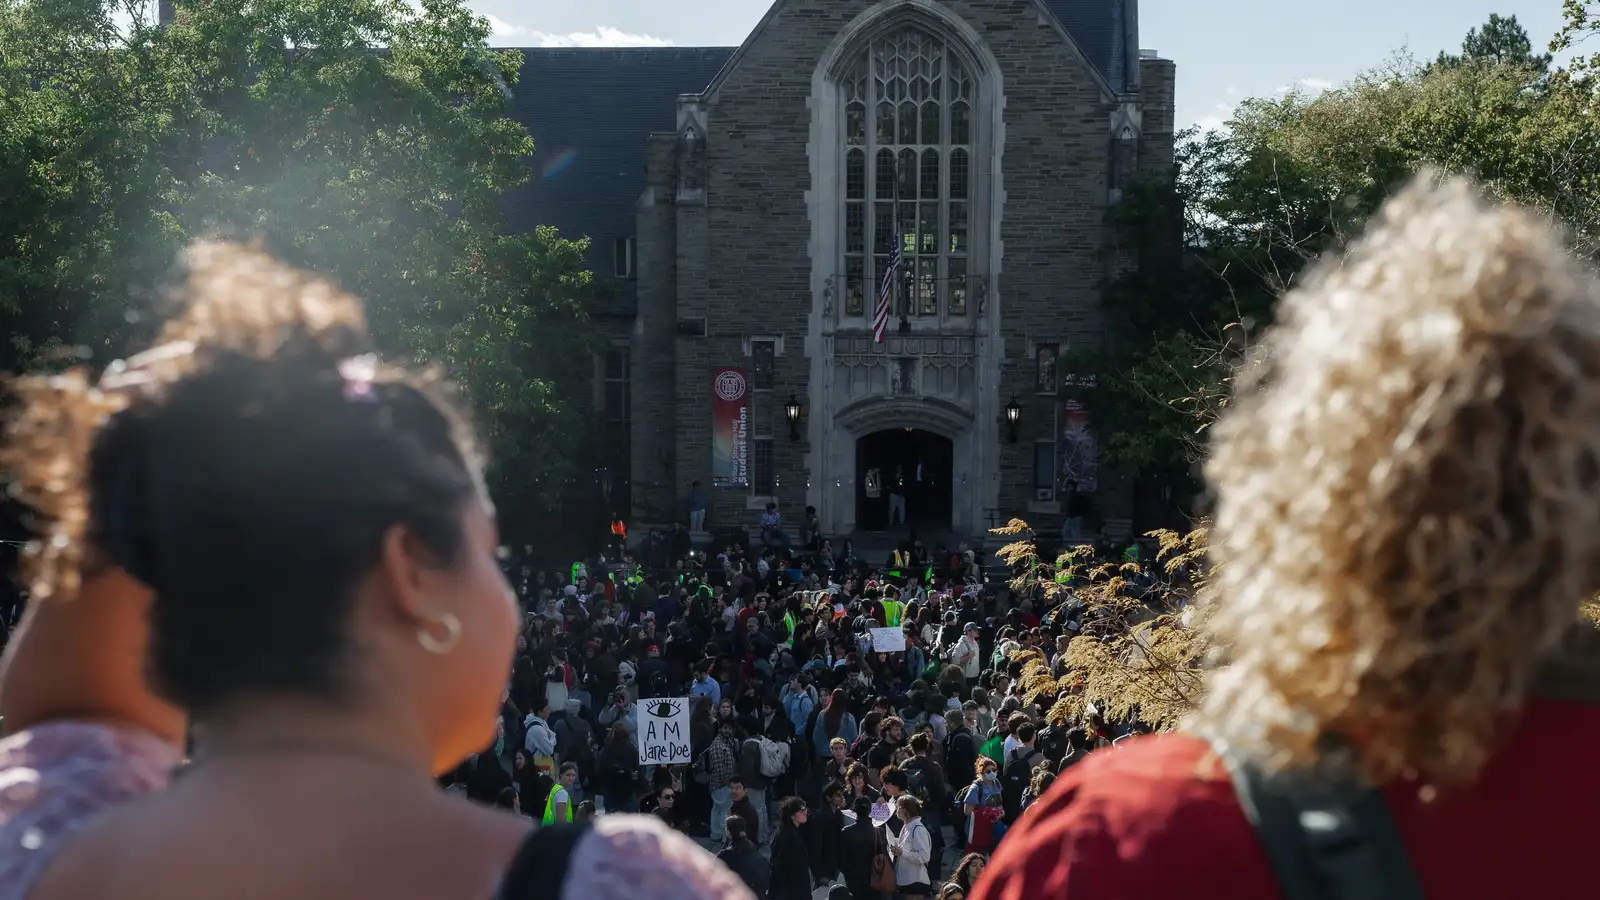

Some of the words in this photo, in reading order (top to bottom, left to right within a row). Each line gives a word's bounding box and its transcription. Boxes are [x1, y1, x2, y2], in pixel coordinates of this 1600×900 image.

[738, 406, 747, 438] Union
[738, 441, 747, 483] Student
[641, 741, 668, 763] Jane
[670, 741, 691, 762] Doe
